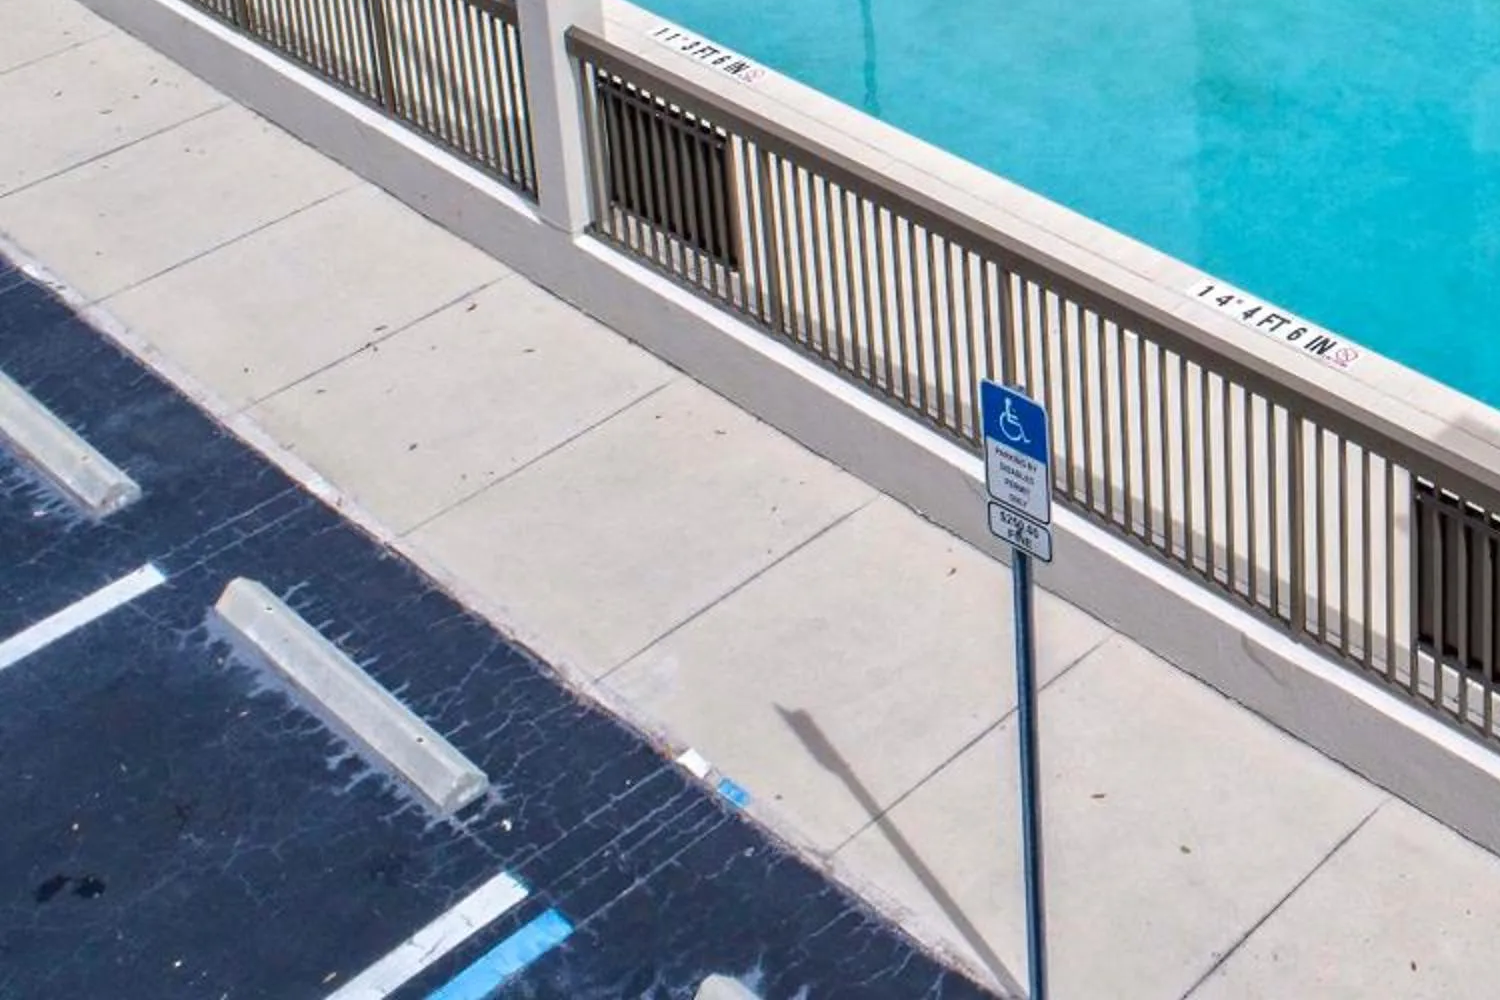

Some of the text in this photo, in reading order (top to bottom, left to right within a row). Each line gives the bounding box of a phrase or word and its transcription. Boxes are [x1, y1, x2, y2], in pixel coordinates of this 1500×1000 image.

[691, 45, 721, 59] FT
[1242, 306, 1263, 321] 4
[1255, 313, 1293, 332] FT
[1286, 327, 1309, 341] 6
[1303, 335, 1339, 357] IN
